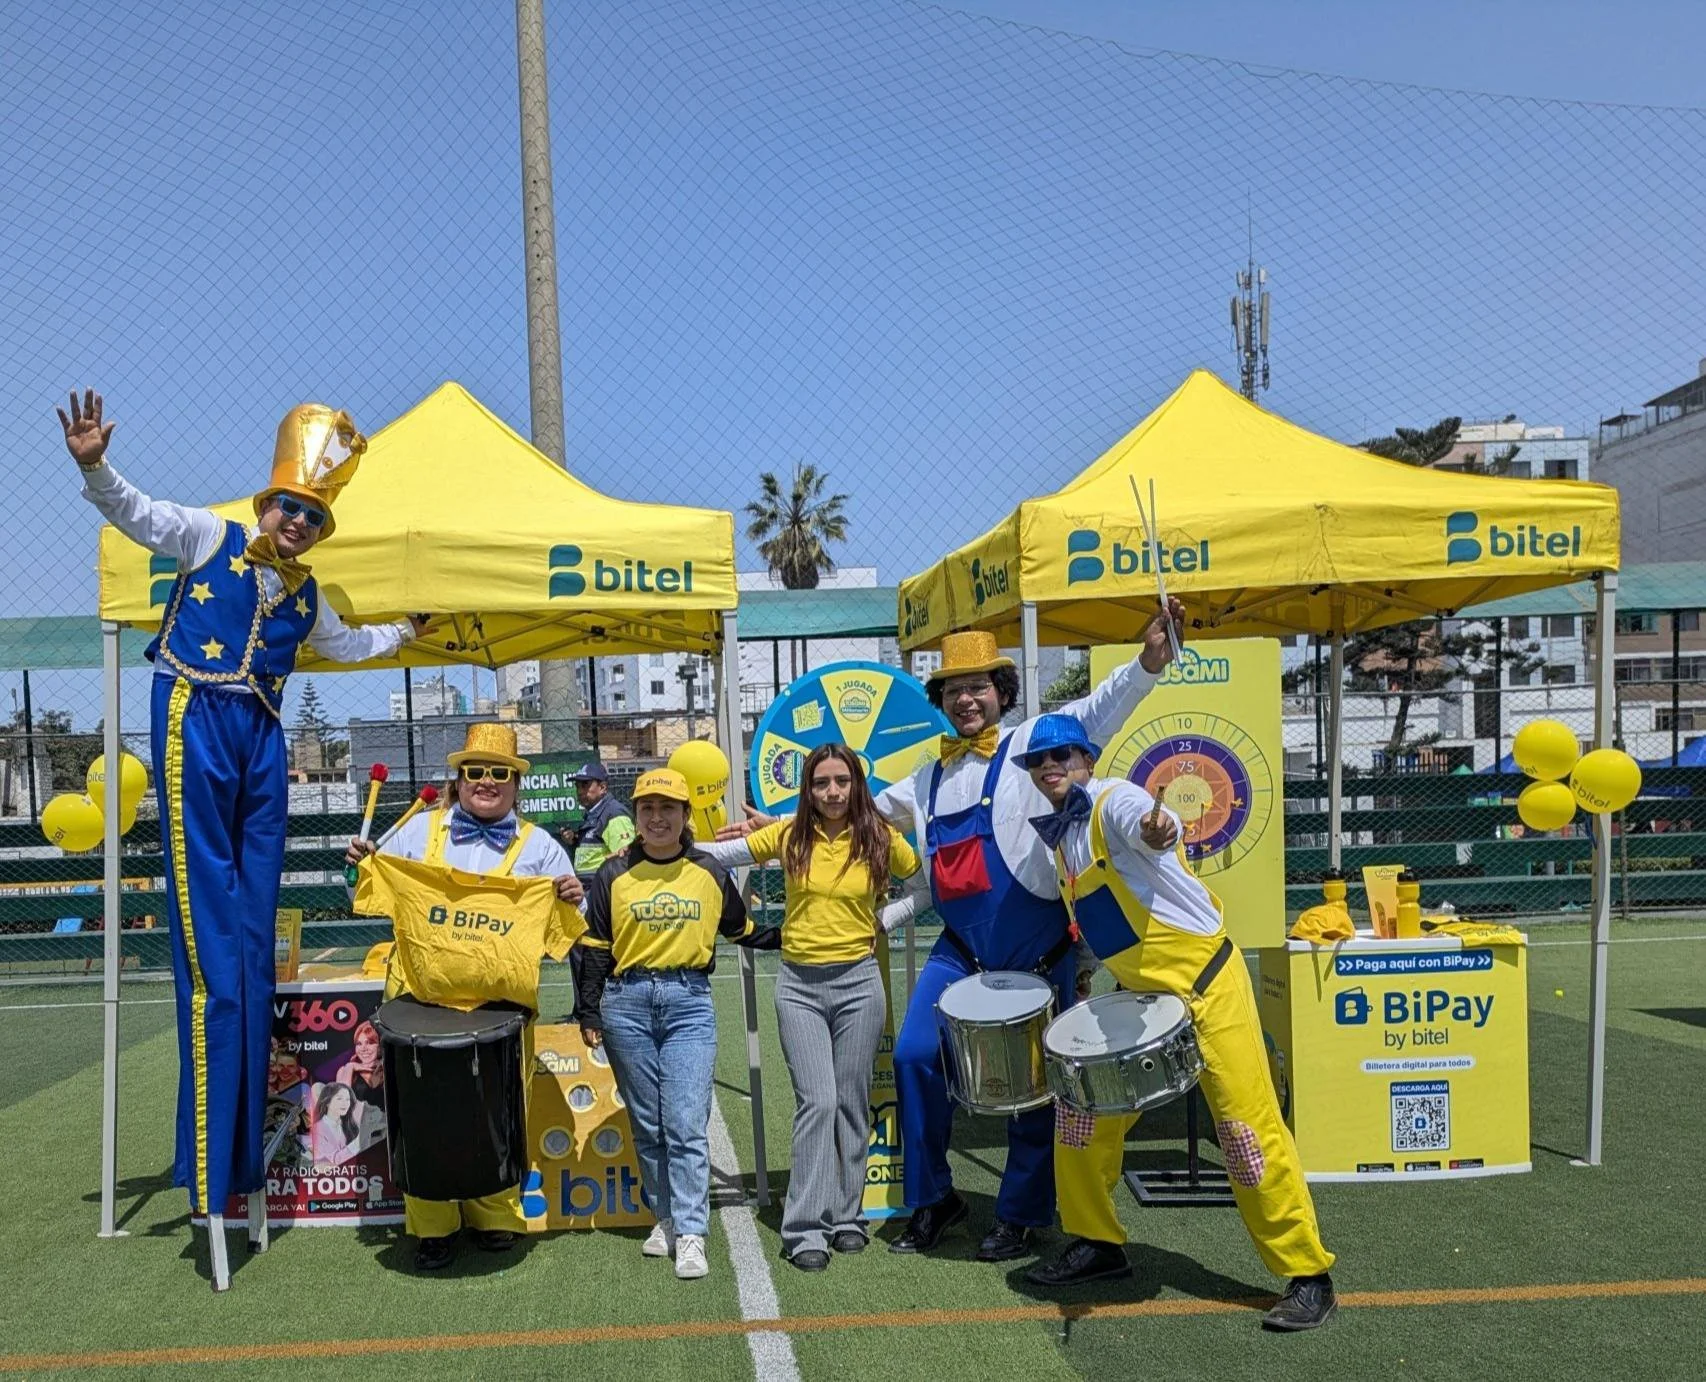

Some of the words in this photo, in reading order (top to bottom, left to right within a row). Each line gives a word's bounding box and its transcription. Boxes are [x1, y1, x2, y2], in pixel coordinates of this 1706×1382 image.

[1489, 525, 1581, 557] bitel
[1113, 540, 1209, 574] bitel
[594, 559, 693, 593] bitel
[982, 560, 1010, 598] bitel
[911, 600, 930, 630] bitel
[843, 680, 877, 697] JUGADA
[1178, 717, 1192, 729] 10
[1179, 741, 1192, 752] 25
[763, 743, 782, 785] JUGADA
[1178, 761, 1194, 773] 75
[87, 773, 105, 783] bite
[521, 797, 576, 813] GMENTO
[1178, 793, 1195, 803] 100
[1579, 788, 1611, 808] bitel
[453, 911, 514, 936] BiPay
[452, 931, 462, 941] by
[1355, 959, 1387, 971] Paga
[1389, 957, 1416, 970] aquí
[1418, 958, 1441, 967] con
[1443, 956, 1475, 968] BiPay
[1383, 990, 1494, 1028] BiPay
[288, 1041, 302, 1053] by
[304, 1041, 328, 1051] bitel
[1384, 1030, 1407, 1050] by
[1412, 1028, 1449, 1045] bitel
[1365, 1062, 1400, 1070] Billetera
[1402, 1060, 1427, 1070] digital
[1429, 1060, 1447, 1069] para
[1449, 1059, 1471, 1067] todos
[1391, 1085, 1430, 1094] DESCARGA
[283, 1166, 320, 1177] RADIO
[323, 1165, 368, 1176] GRATIS
[266, 1178, 298, 1196] RA
[561, 1166, 650, 1217] bit
[291, 1203, 306, 1212] YA!
[321, 1201, 344, 1210] Google
[344, 1201, 357, 1209] Play
